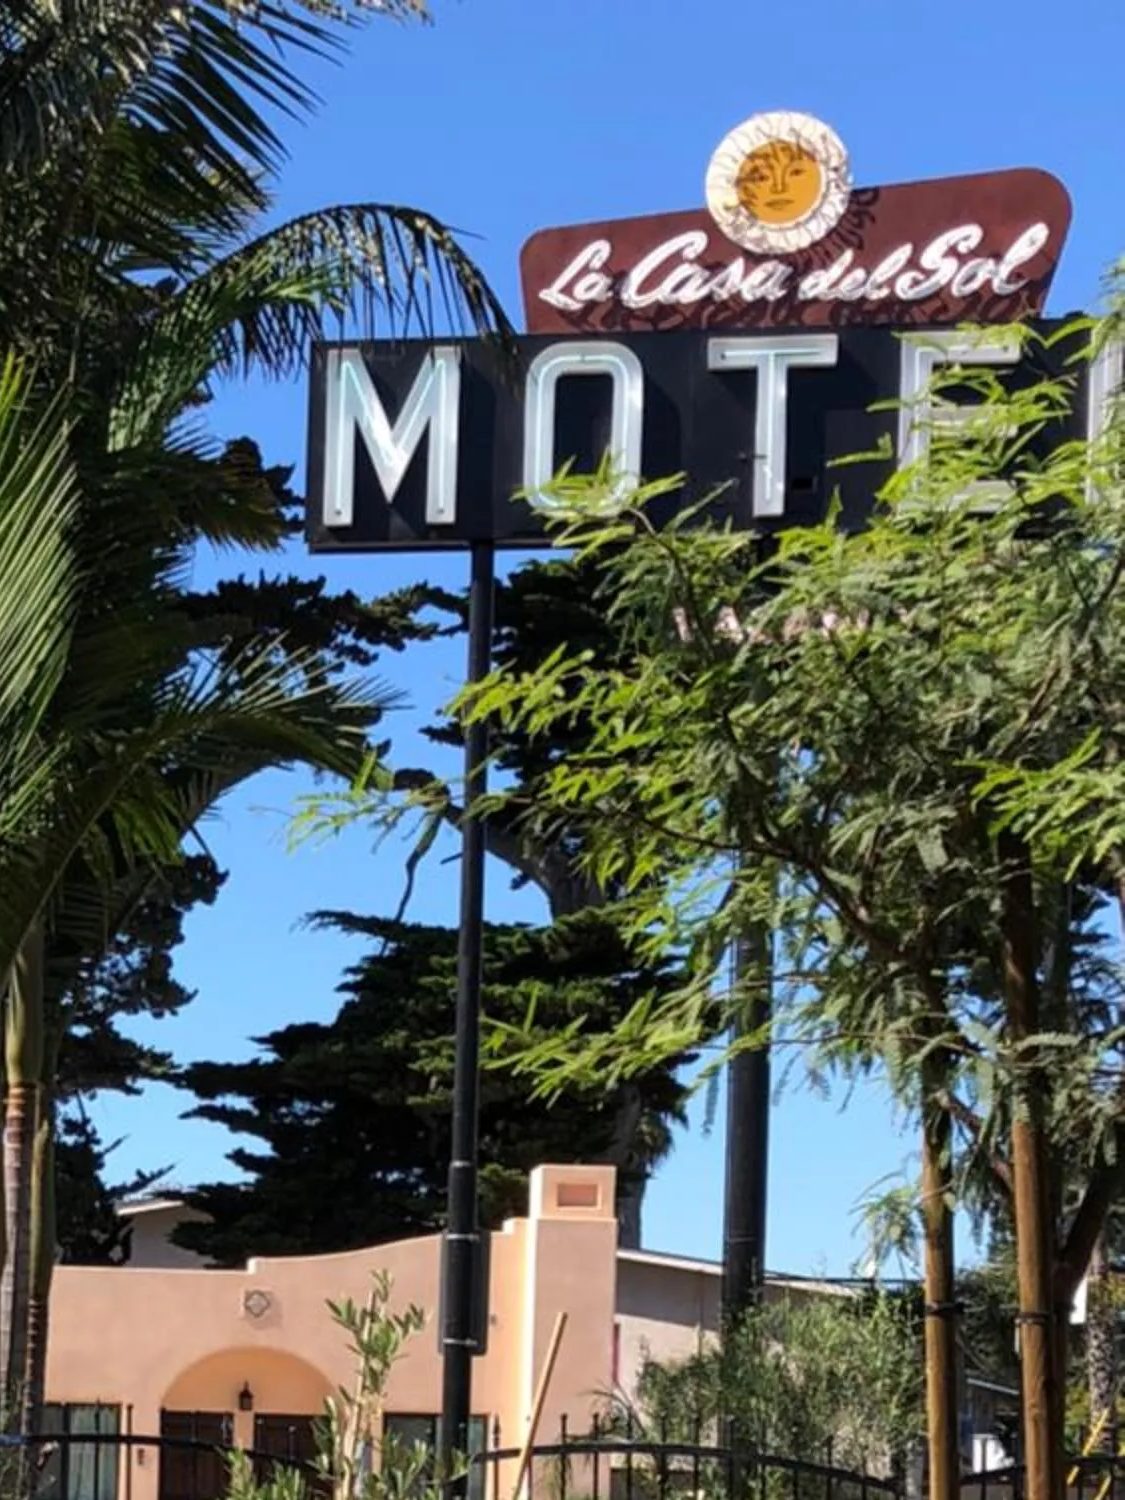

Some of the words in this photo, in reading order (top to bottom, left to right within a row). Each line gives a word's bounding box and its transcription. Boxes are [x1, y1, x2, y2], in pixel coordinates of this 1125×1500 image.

[538, 239, 613, 311] La
[620, 230, 794, 308] Casa
[797, 243, 913, 300] del
[894, 222, 1050, 301] Sol
[322, 330, 1125, 528] MOTE
